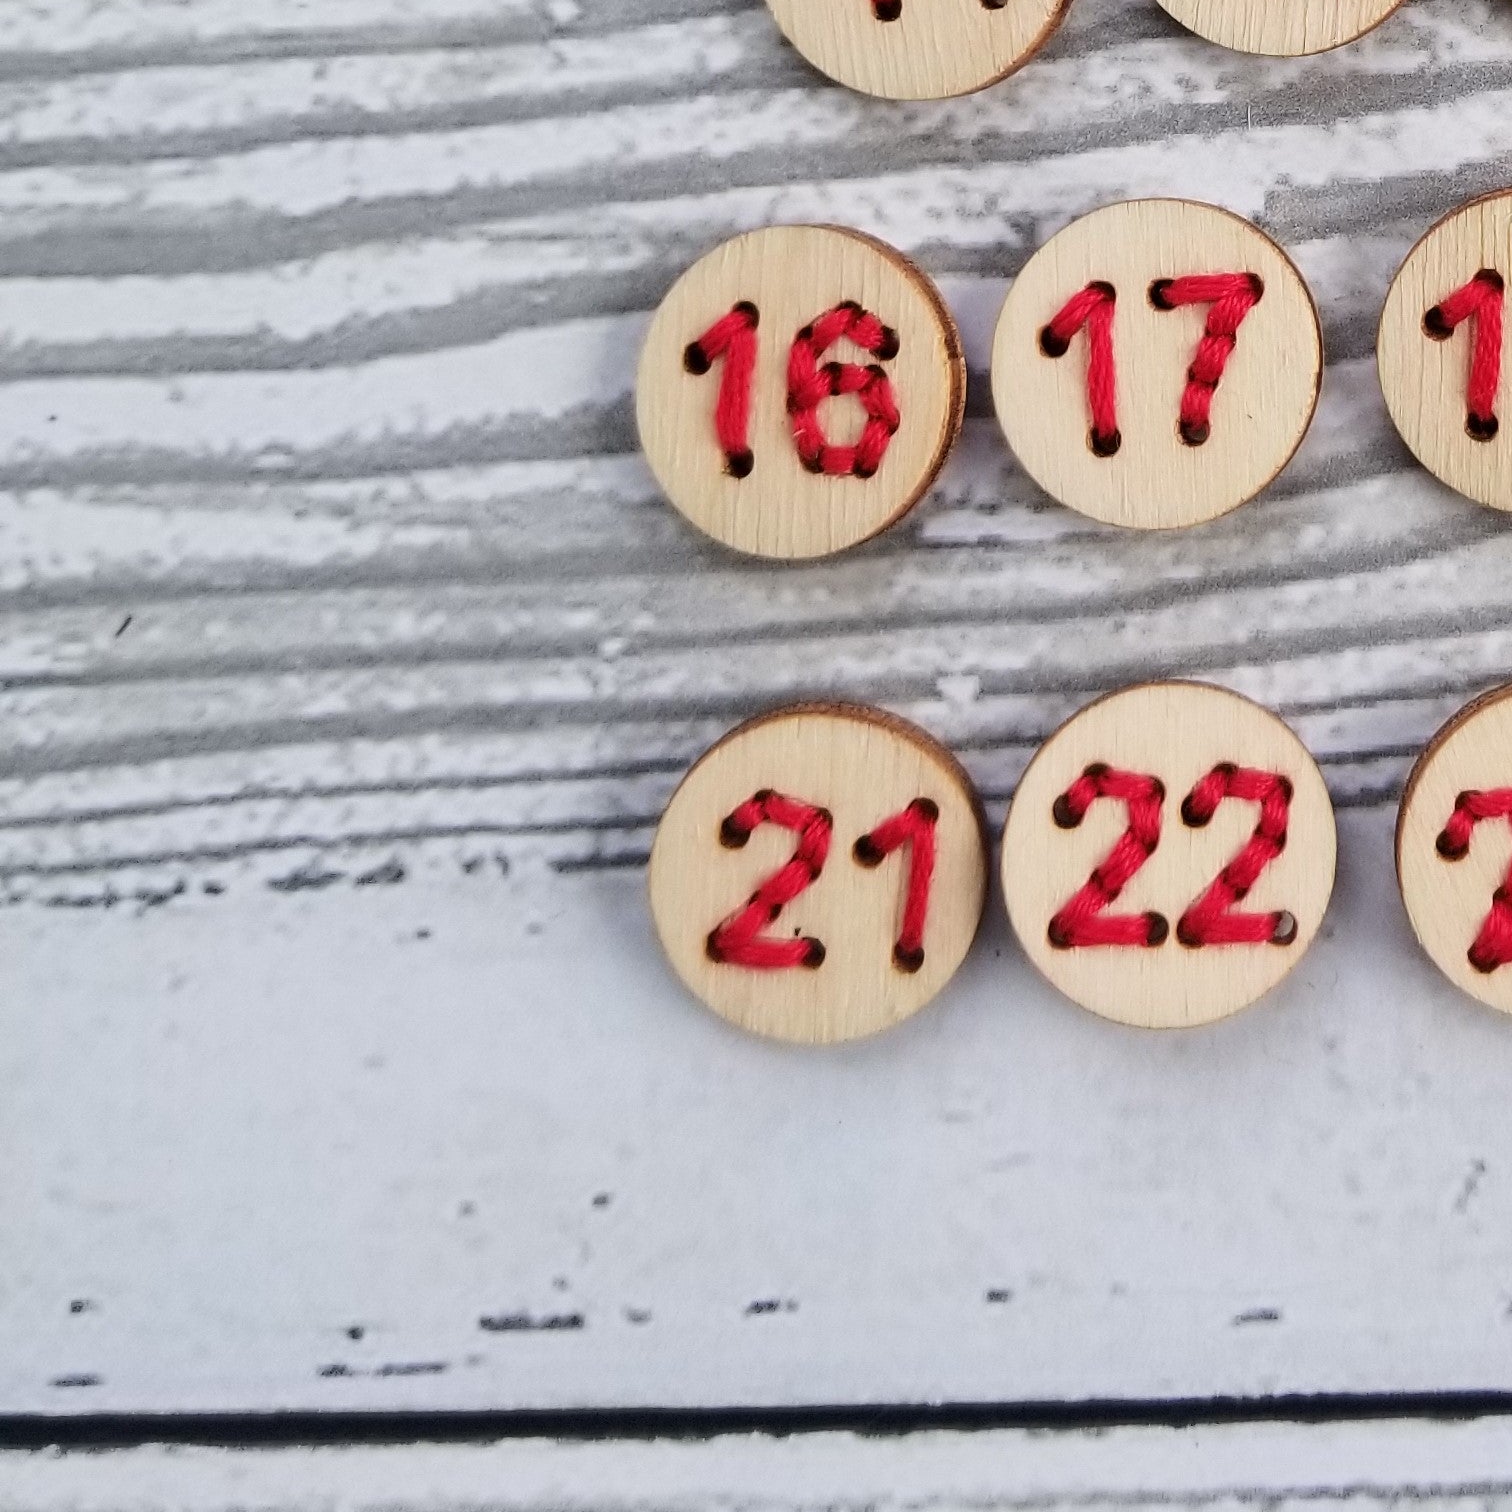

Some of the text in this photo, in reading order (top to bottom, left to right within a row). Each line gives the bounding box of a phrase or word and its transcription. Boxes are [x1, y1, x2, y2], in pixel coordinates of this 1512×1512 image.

[685, 301, 900, 479] 16
[1041, 271, 1264, 457] 17
[707, 790, 939, 973] 21
[1048, 762, 1297, 949] 22
